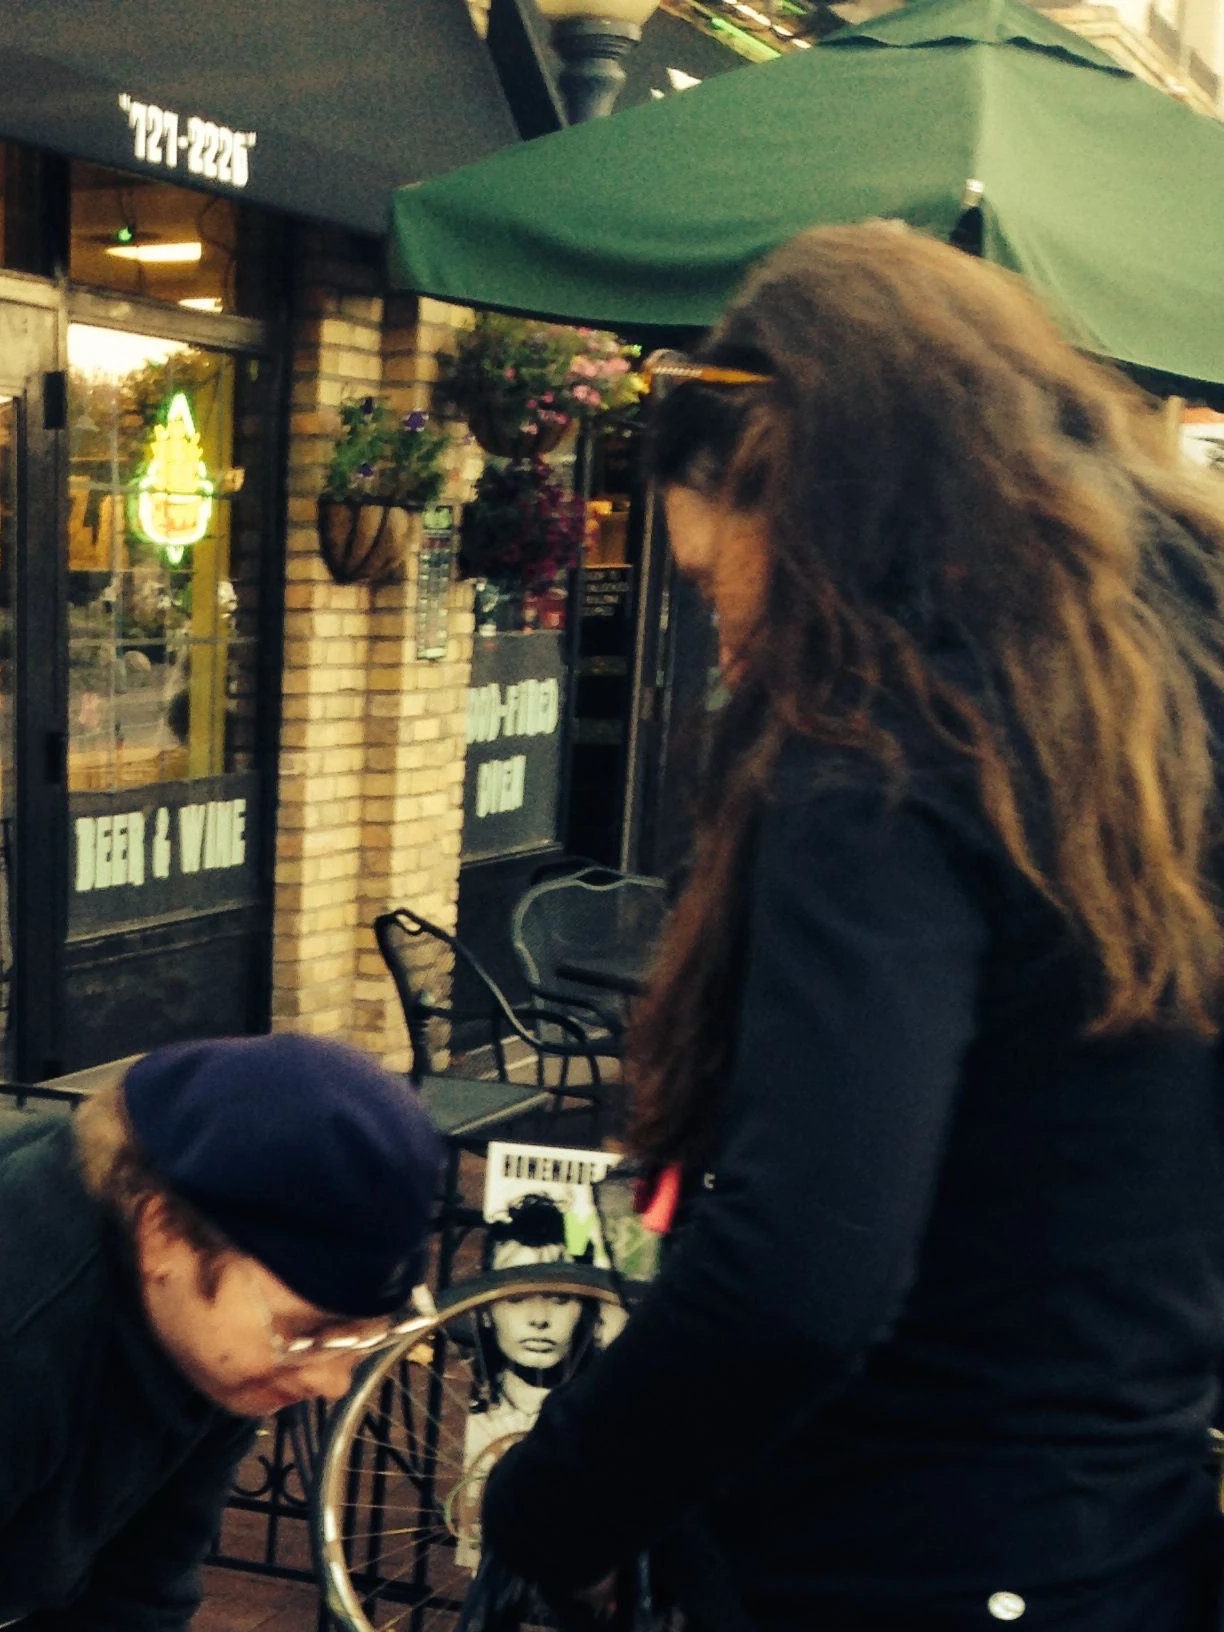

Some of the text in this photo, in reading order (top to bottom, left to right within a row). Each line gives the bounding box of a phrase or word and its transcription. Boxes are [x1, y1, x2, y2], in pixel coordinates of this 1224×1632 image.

[75, 798, 247, 892] BEER & WINE
